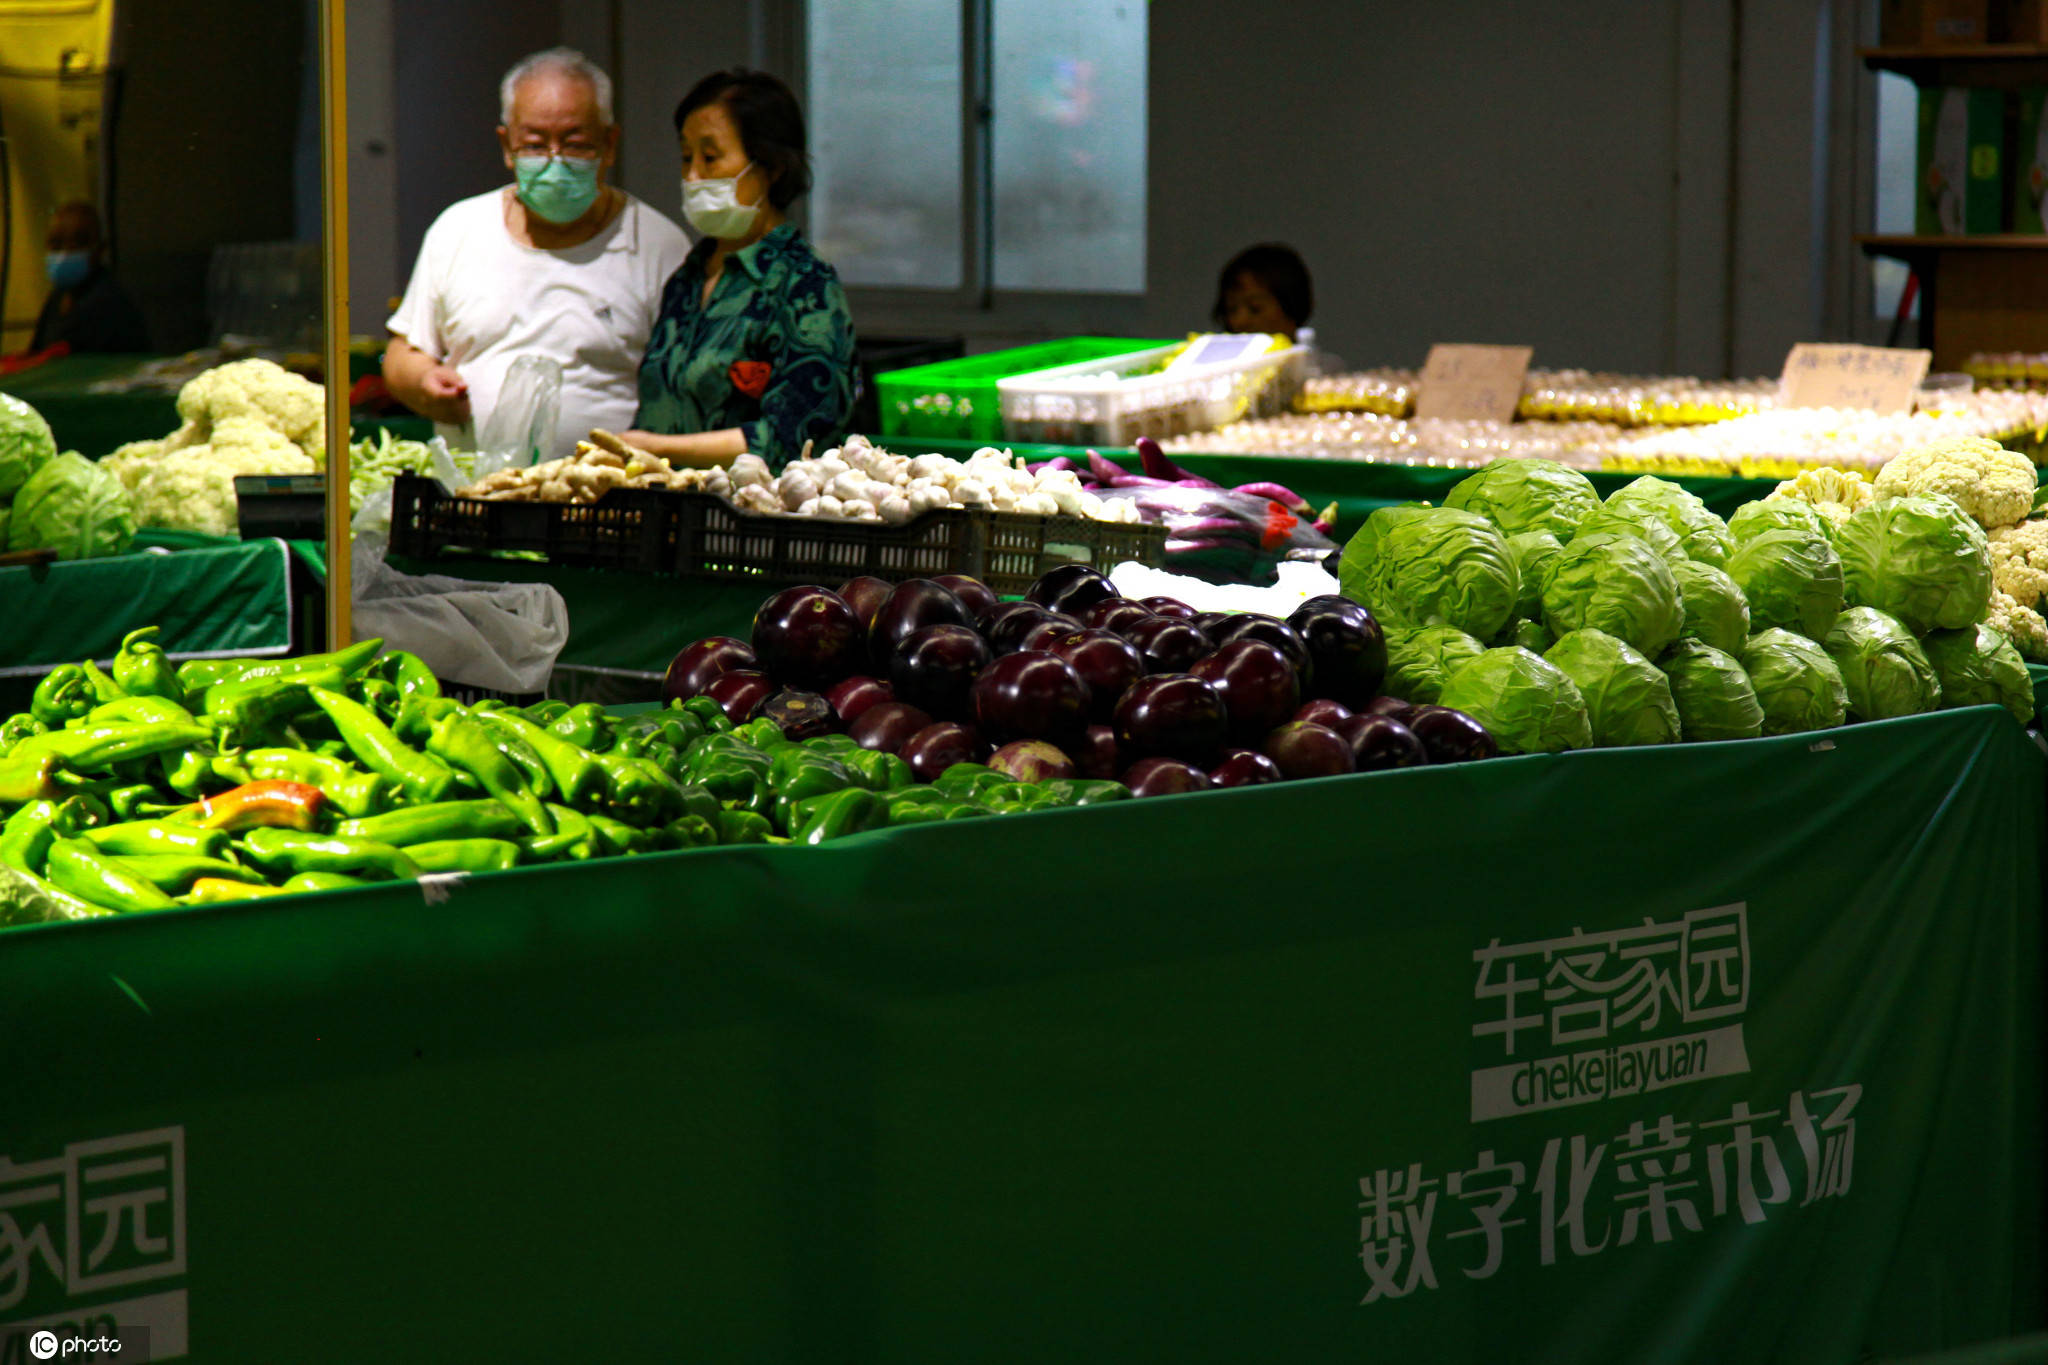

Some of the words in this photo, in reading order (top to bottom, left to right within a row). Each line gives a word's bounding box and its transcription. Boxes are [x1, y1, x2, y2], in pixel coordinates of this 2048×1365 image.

[1471, 900, 1750, 1056] 车客家园
[1511, 1035, 1708, 1107] chekejiayuan
[1357, 1082, 1864, 1306] 数字化菜市场
